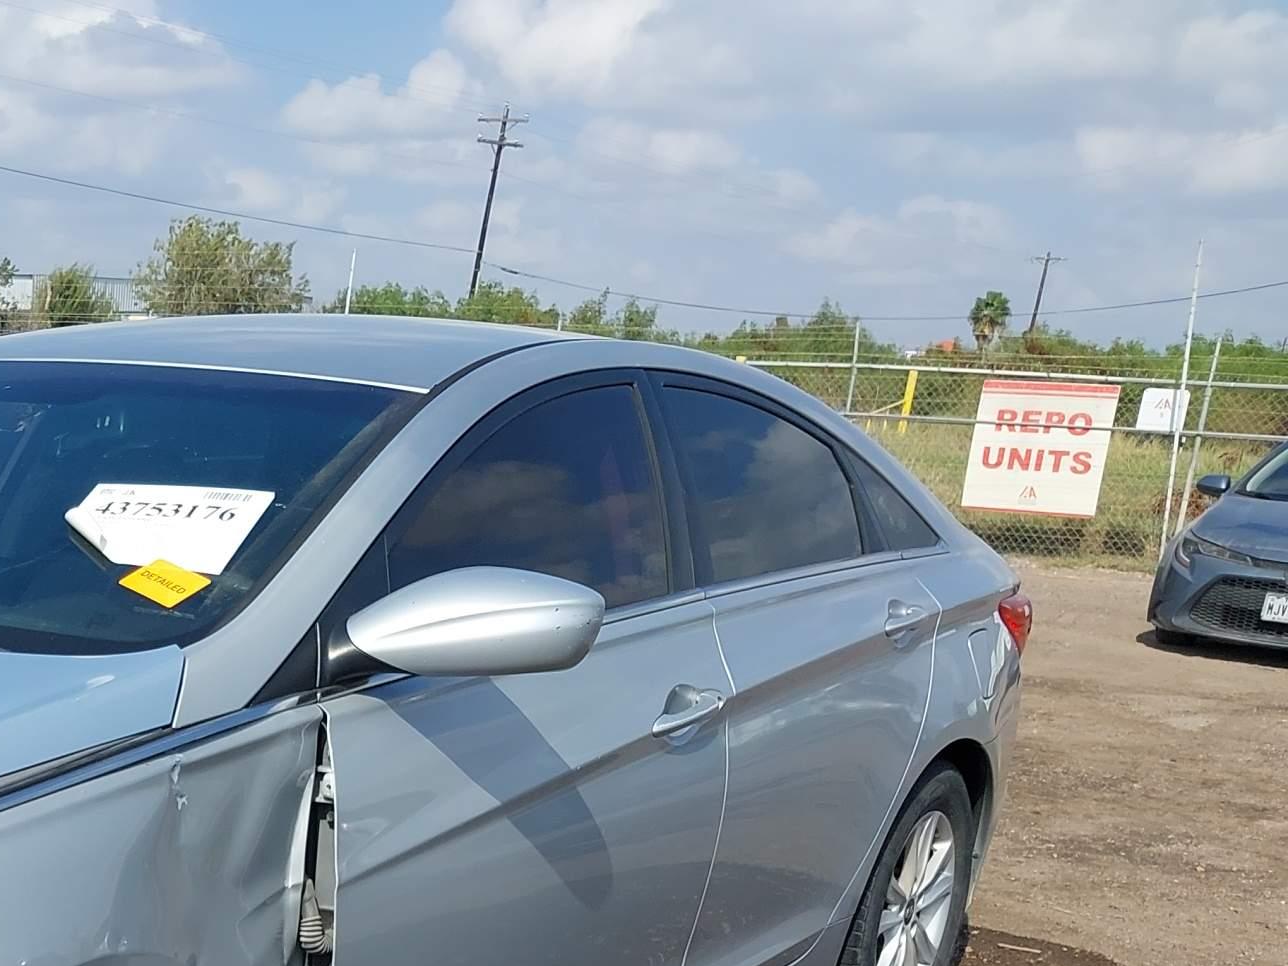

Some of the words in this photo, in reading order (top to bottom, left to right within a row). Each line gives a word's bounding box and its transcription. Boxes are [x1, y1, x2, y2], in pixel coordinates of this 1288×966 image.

[995, 409, 1092, 436] REPO
[982, 447, 1092, 474] UNITS
[96, 501, 238, 521] 43753176
[140, 570, 186, 594] DETAILED
